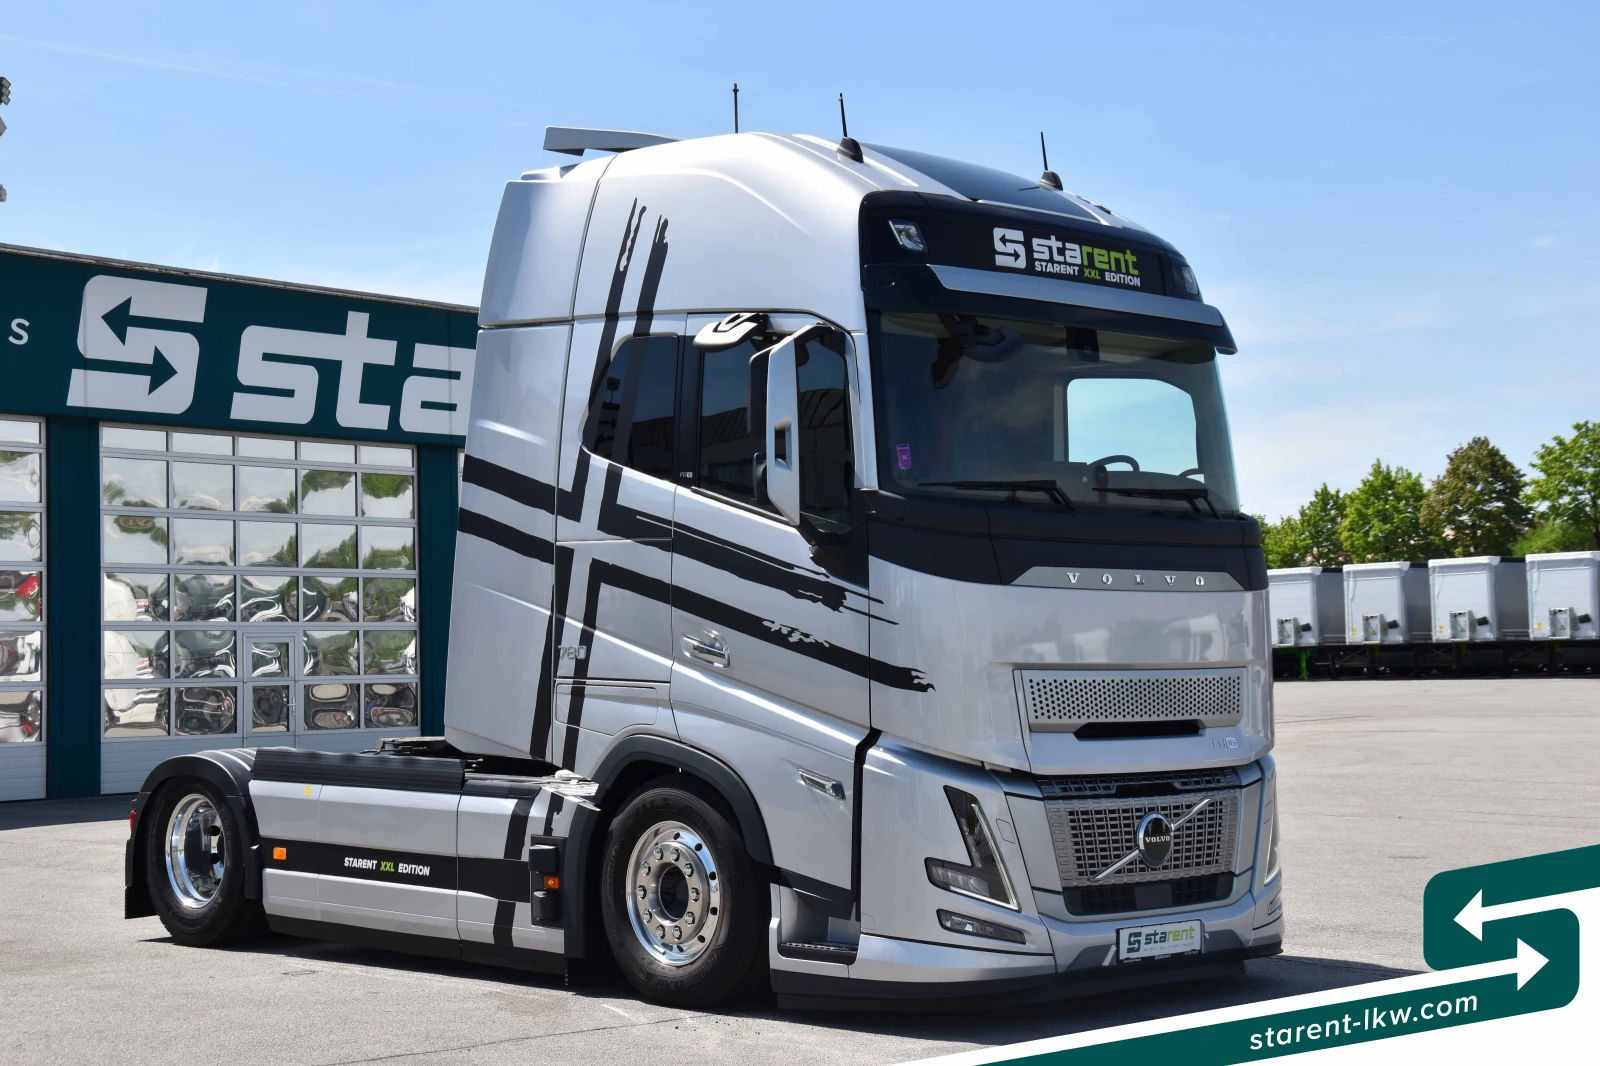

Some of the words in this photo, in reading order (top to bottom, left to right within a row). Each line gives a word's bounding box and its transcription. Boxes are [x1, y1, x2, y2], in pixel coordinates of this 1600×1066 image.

[1032, 235, 1139, 276] starent
[1034, 261, 1080, 276] STARENT
[1083, 269, 1101, 280] XXL
[1105, 271, 1141, 287] EDITION
[1066, 572, 1205, 586] VOLVO
[1145, 835, 1171, 843] VOLVO
[344, 857, 378, 870] STARENT
[379, 861, 395, 872] XXL
[398, 863, 430, 876] EDITION
[1144, 925, 1195, 946] starent
